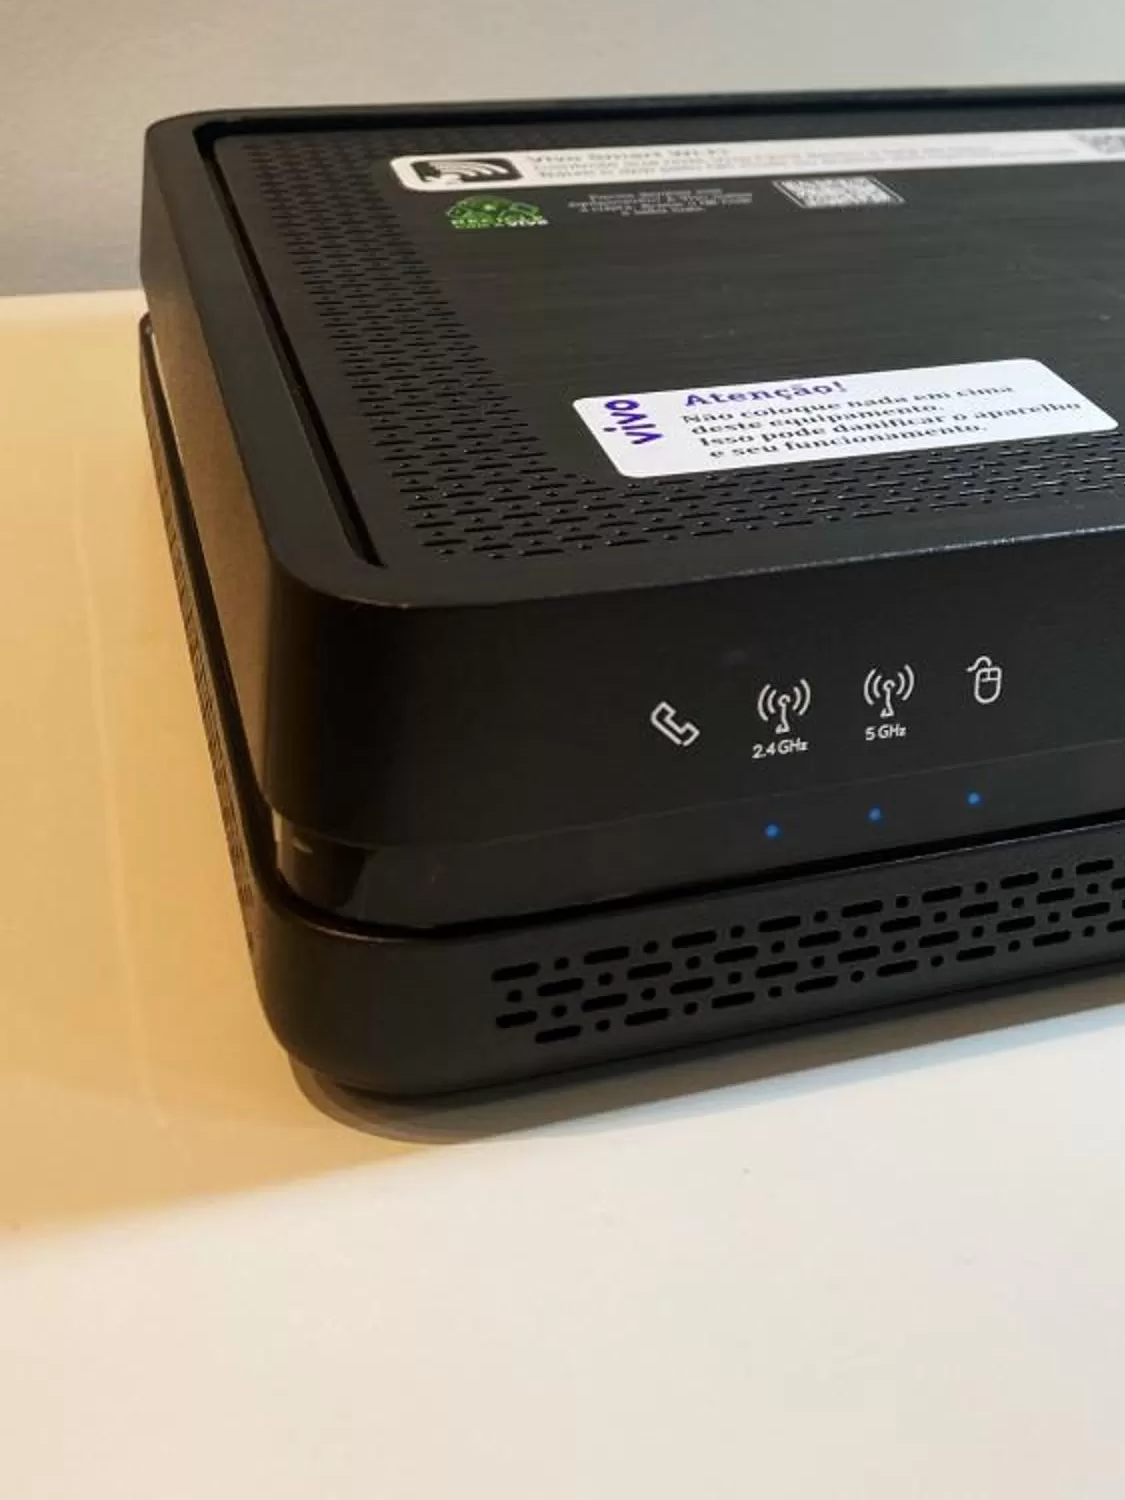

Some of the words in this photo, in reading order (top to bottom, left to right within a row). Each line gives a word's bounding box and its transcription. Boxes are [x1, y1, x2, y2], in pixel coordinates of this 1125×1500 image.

[682, 411, 734, 425] Não
[740, 401, 842, 419] coloque
[847, 395, 908, 409] nada
[913, 390, 951, 401] em
[956, 385, 1015, 399] cima
[685, 380, 847, 407] Atenção!
[604, 399, 663, 445] vivo
[691, 421, 762, 435] deste
[769, 404, 945, 427] equipamento.
[700, 435, 755, 447] Isso
[761, 427, 826, 443] pode
[833, 413, 947, 435] danificar
[974, 402, 1082, 421] aparelho
[732, 444, 779, 457] seu
[785, 424, 989, 451] funcionamento.
